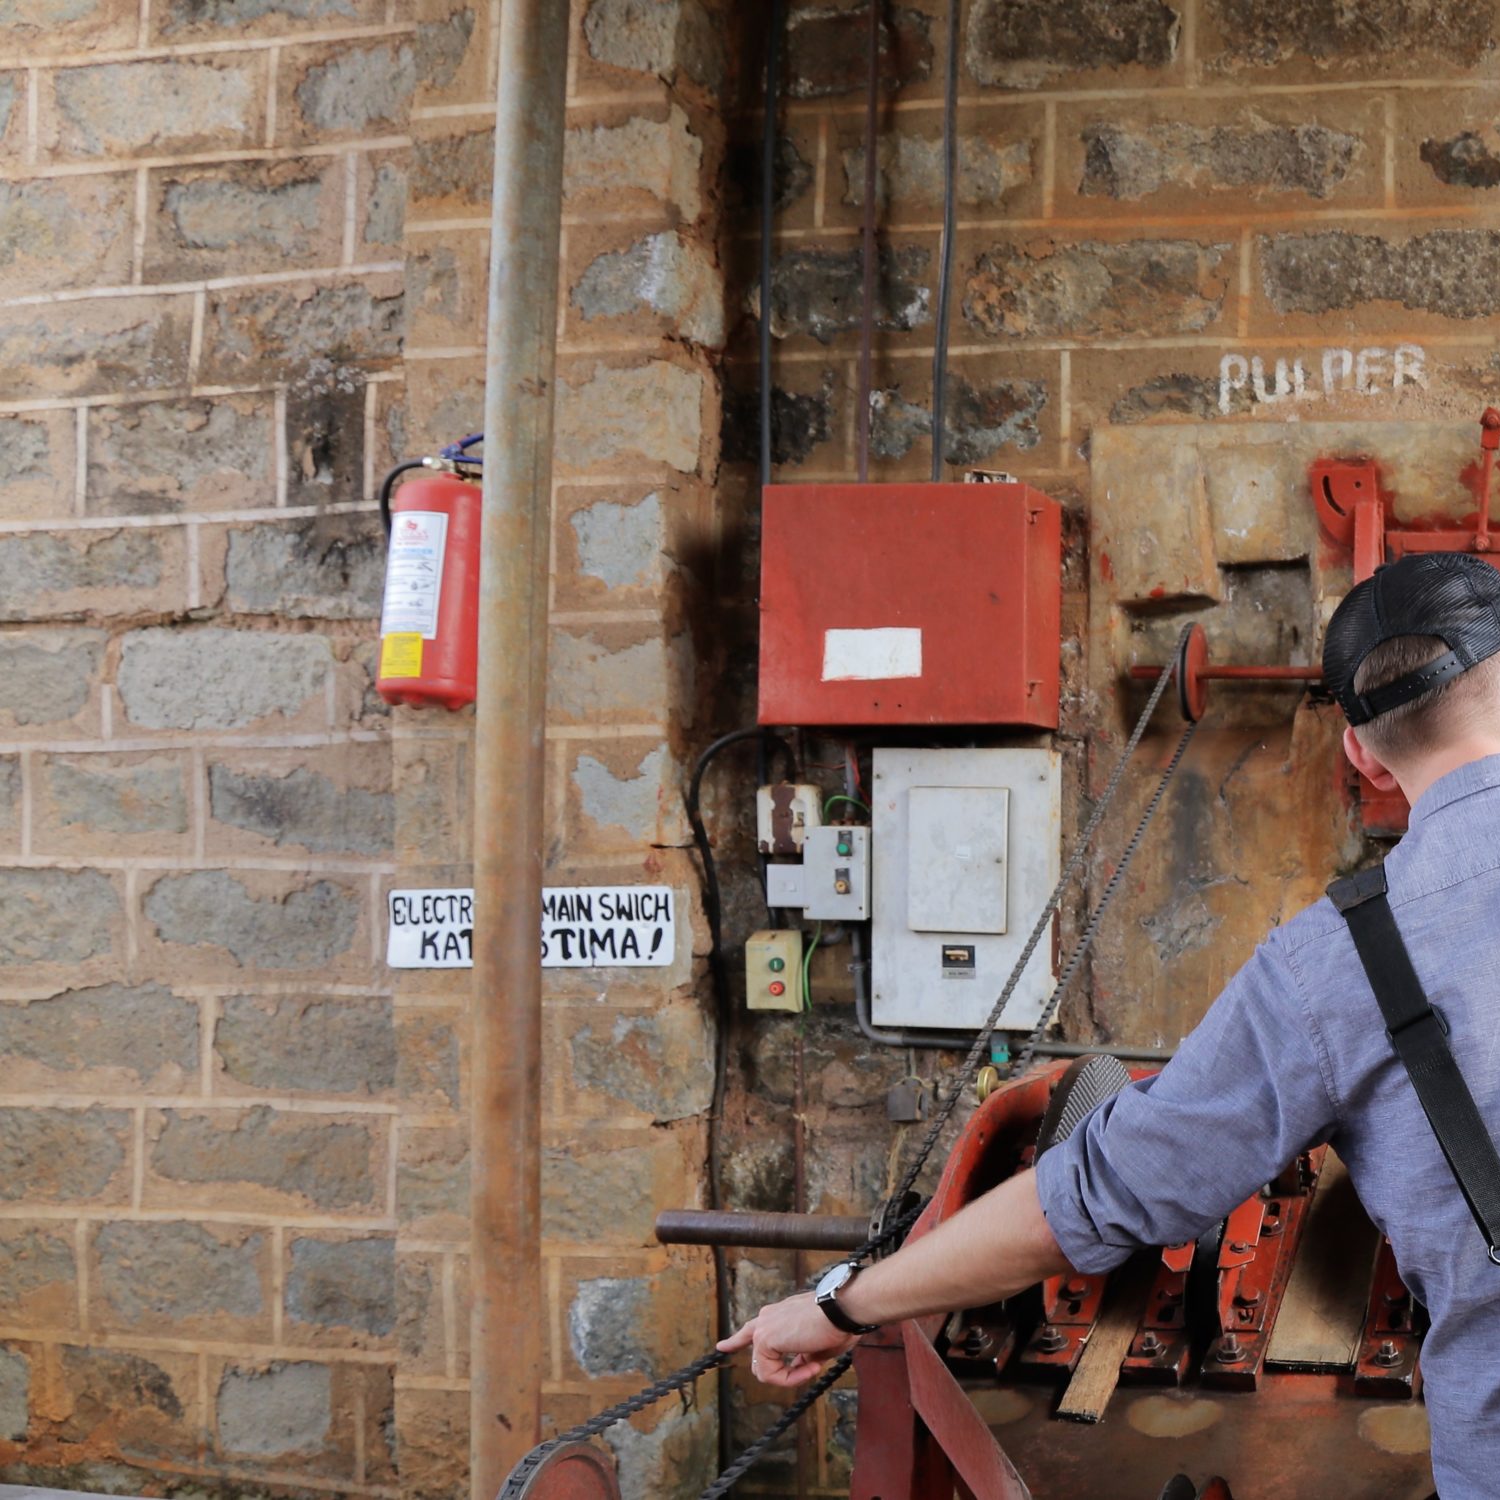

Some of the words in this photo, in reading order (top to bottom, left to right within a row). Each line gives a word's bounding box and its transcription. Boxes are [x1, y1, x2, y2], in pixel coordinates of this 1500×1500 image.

[1218, 343, 1431, 415] PULPER
[392, 895, 473, 926] ELECTR
[542, 894, 593, 922] MAIN
[598, 893, 671, 922] SWICH
[420, 928, 473, 961] KAT
